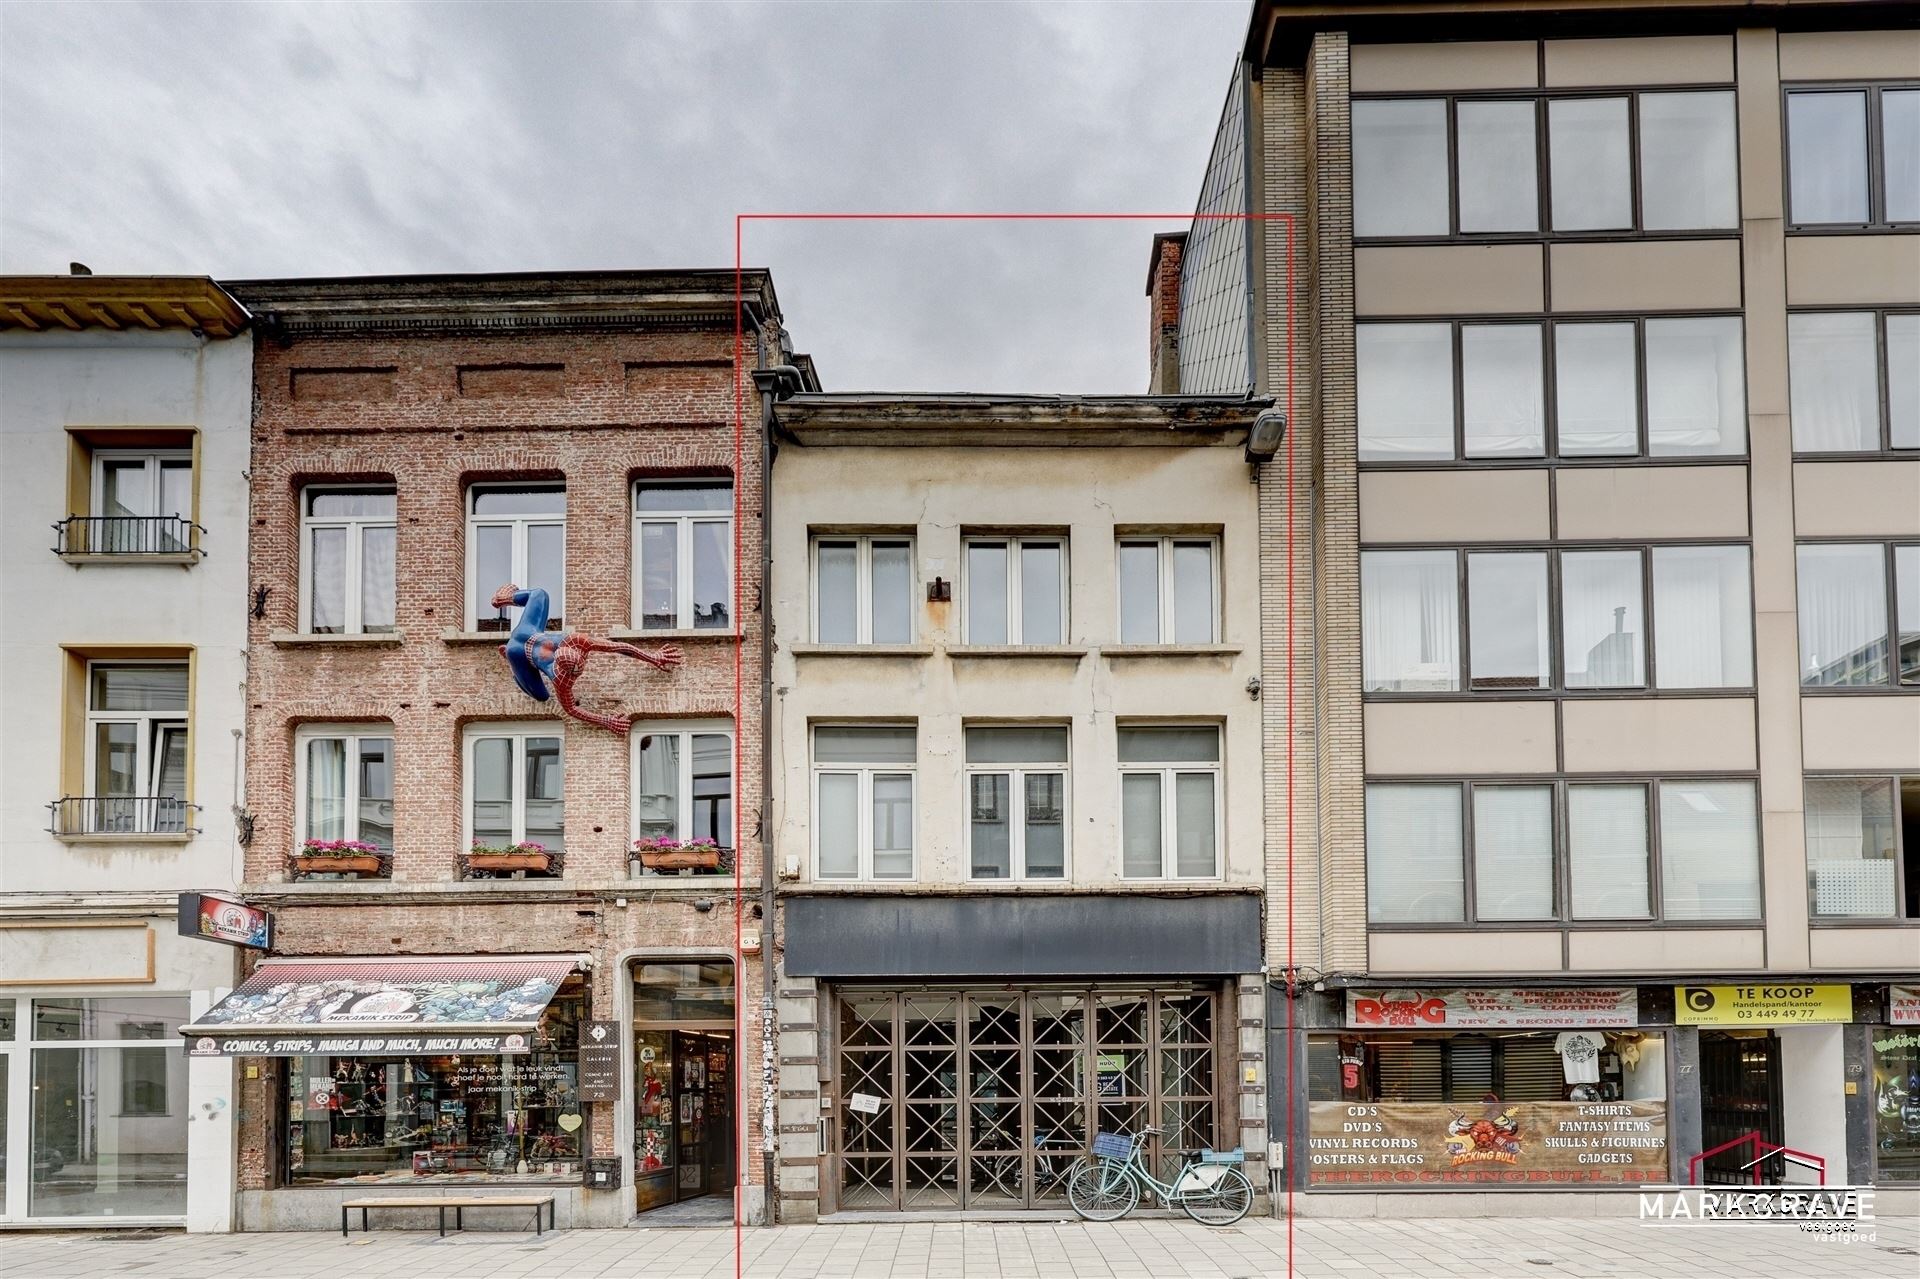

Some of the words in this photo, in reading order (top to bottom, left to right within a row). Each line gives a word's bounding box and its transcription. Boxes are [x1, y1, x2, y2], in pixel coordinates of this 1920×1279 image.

[218, 926, 237, 935] MEKANIK
[1737, 988, 1756, 999] TE
[1763, 988, 1815, 999] KOOP
[1733, 1001, 1822, 1009] Handelspand/kantoor
[1738, 1010, 1752, 1019] 03
[1756, 1010, 1778, 1018] 449
[1782, 1010, 1797, 1018] 49
[1800, 1010, 1815, 1018] 77
[222, 1040, 270, 1052] COMICS,
[273, 1040, 316, 1053] STRIPS,
[318, 1039, 360, 1051] MANGA
[360, 1039, 384, 1051] AND
[385, 1039, 422, 1052] MUCH,
[424, 1038, 461, 1051] MUCH
[462, 1037, 500, 1050] MORE!
[517, 1066, 525, 1074] je
[1680, 1065, 1692, 1073] 77
[1849, 1065, 1862, 1073] 79
[477, 1074, 485, 1082] je
[1344, 1065, 1358, 1088] 5
[468, 1086, 484, 1094] jaar
[1348, 1106, 1378, 1117] CD'S
[1578, 1106, 1632, 1116] T-SHIRTS
[1344, 1122, 1382, 1132] DVD'S
[1559, 1122, 1612, 1132] FANTASY
[1614, 1122, 1650, 1132] ITEMS
[1310, 1139, 1349, 1149] VINYL
[1352, 1138, 1418, 1148] RECORDS
[1545, 1138, 1588, 1148] SKULLS
[1591, 1138, 1600, 1148] &
[1602, 1138, 1665, 1148] FIGURINES
[1368, 1155, 1378, 1164] &
[1382, 1155, 1424, 1164] FLAGS
[1451, 1151, 1494, 1166] ROCKING
[1495, 1151, 1518, 1164] BULL
[1578, 1154, 1633, 1164] GADGETS
[1310, 1170, 1667, 1183] THEROCKINGBULL.BE
